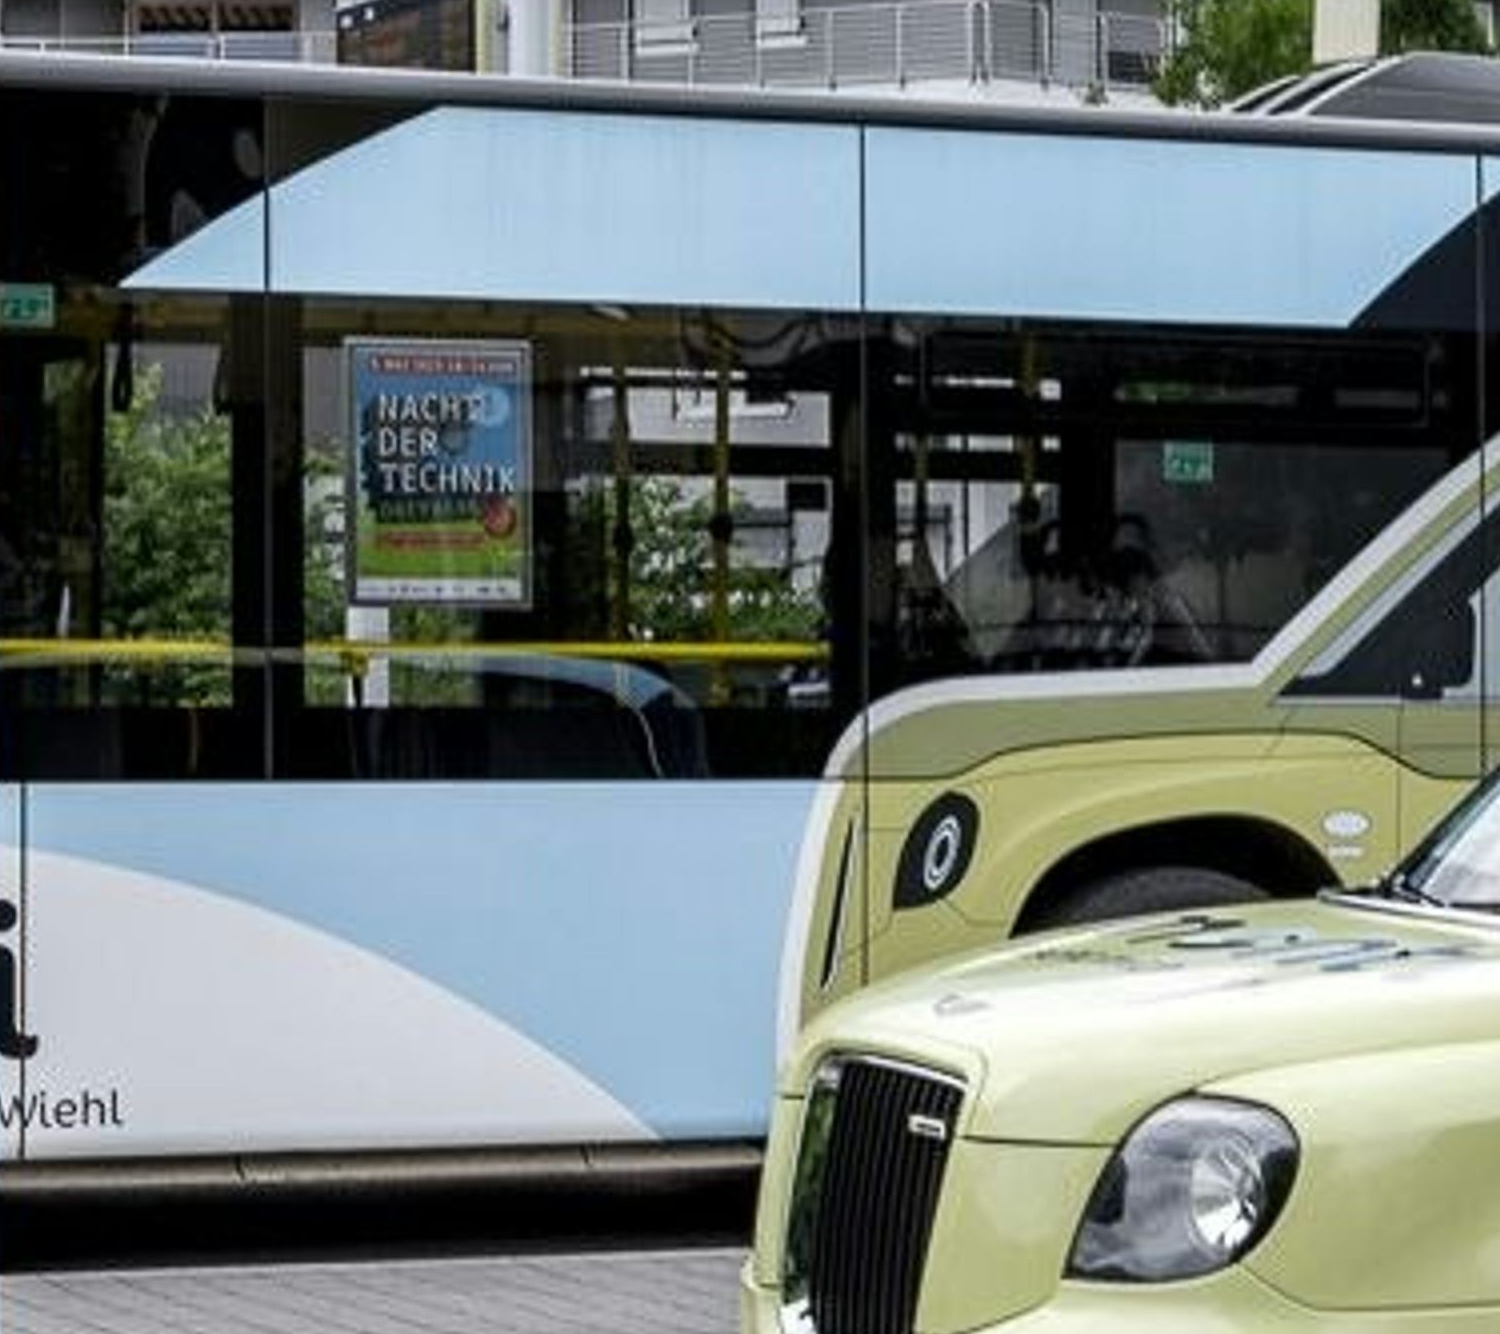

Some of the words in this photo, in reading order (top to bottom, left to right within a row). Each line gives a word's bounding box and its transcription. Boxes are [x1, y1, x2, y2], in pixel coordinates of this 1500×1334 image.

[377, 391, 486, 422] NACHT
[378, 425, 438, 457] DER
[380, 462, 517, 494] TECHNIK
